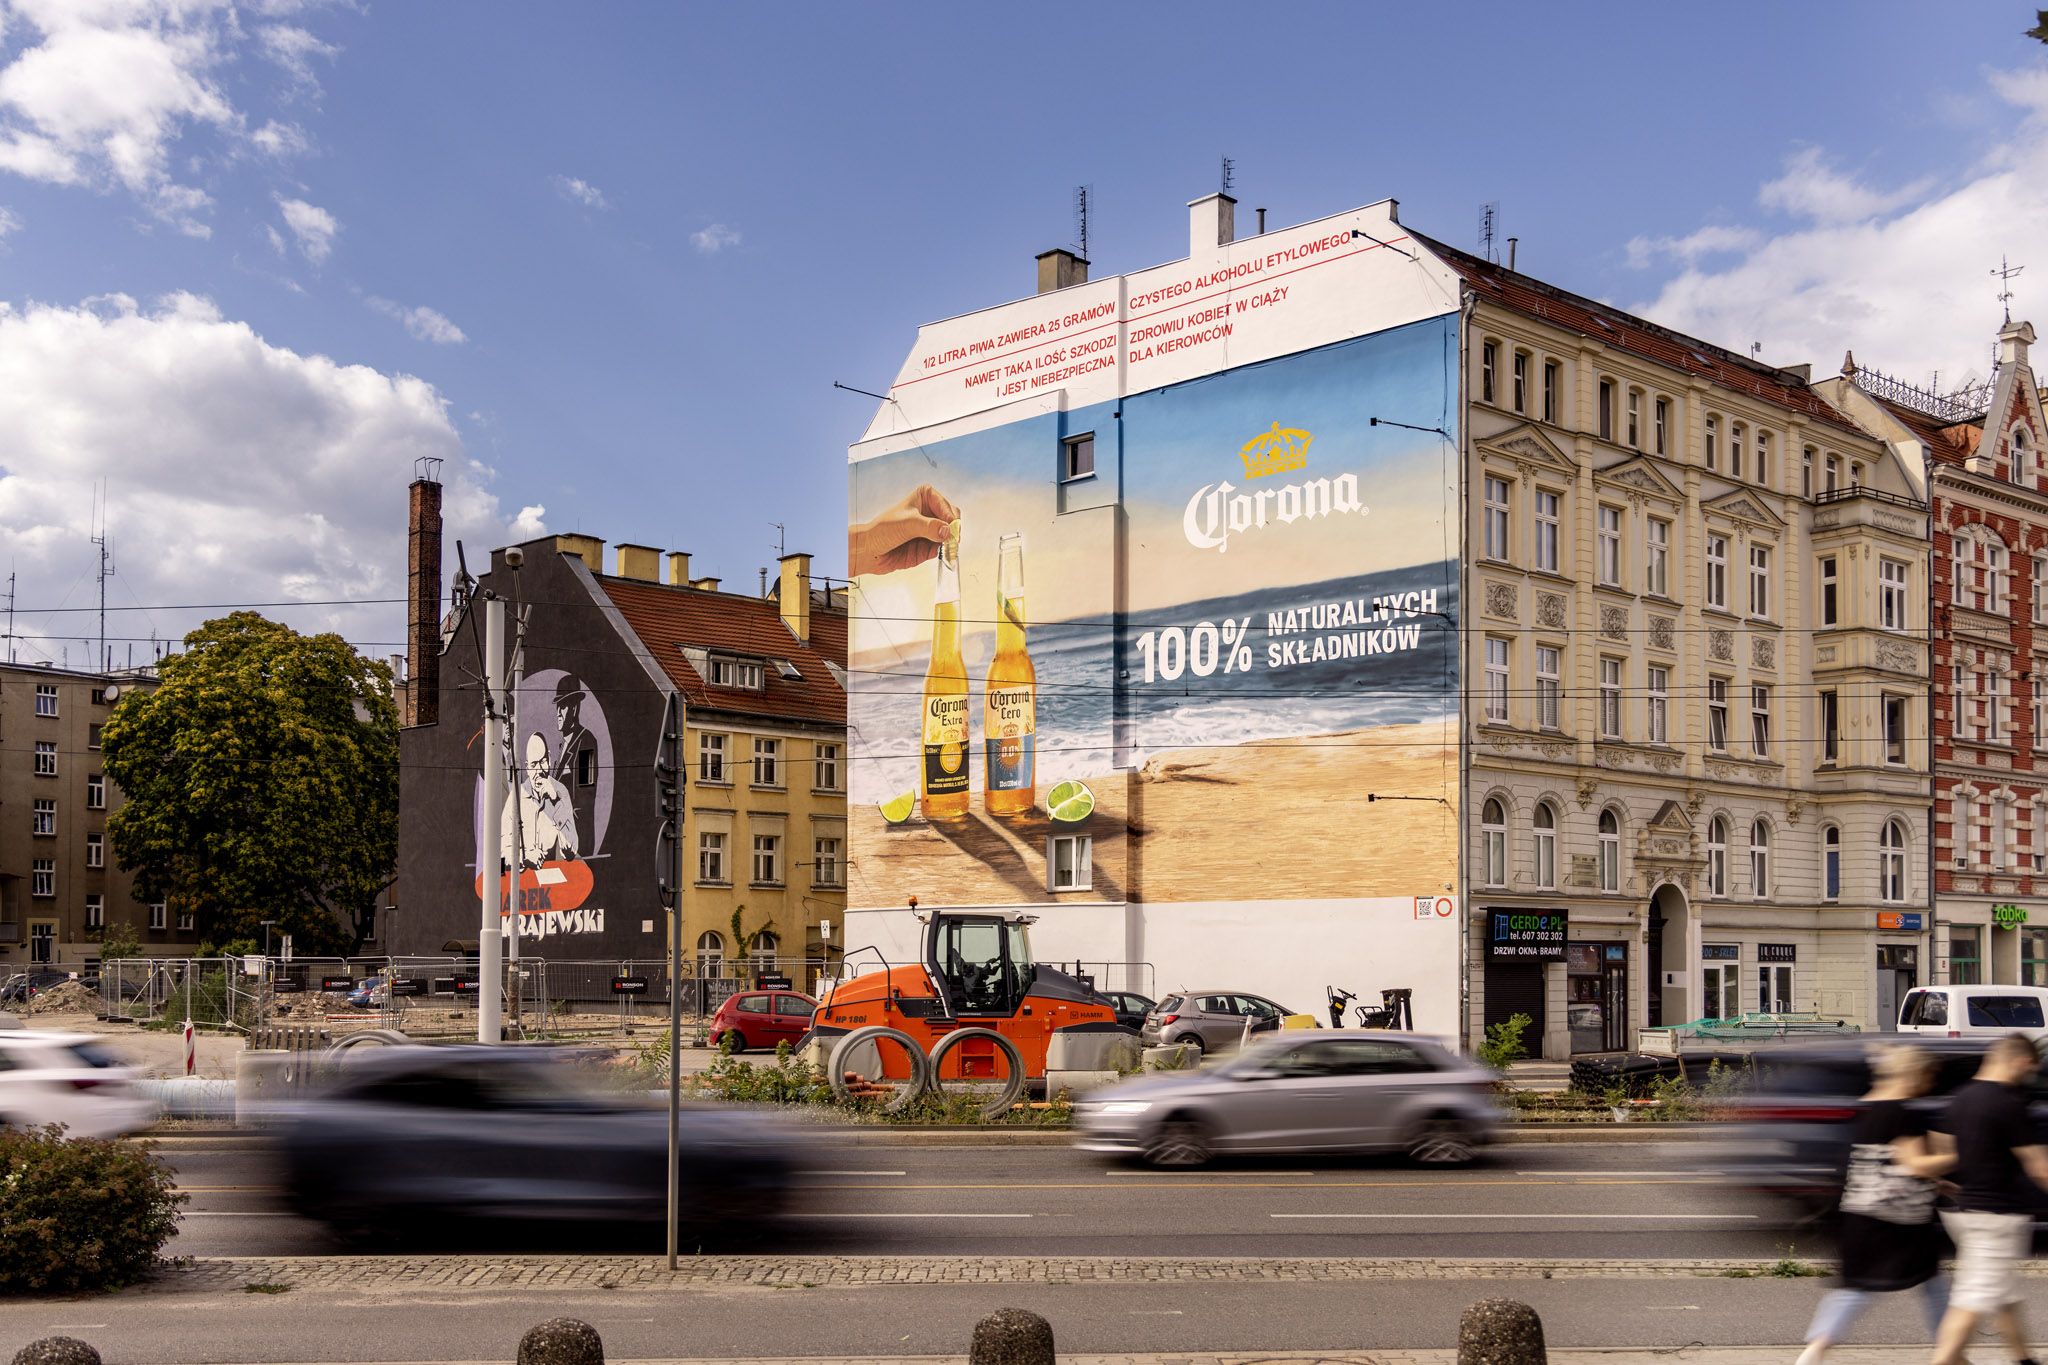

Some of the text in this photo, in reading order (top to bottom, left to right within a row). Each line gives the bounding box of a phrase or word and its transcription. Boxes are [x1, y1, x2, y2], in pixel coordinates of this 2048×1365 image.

[923, 231, 1351, 369] 1/2 LITRA PIWA ZAWIERA 25 GRAMÓW CZYSTEGO ALKOHOLU ETYLOWEGO
[965, 286, 1290, 389] NAWET TAKA ILOŚĆ SZKODZI ZDROWIU KOBIET W CIĄŻY
[996, 323, 1234, 398] I JEST NIEBEZPIECZNA DLA KIEROWCÓW
[1183, 472, 1364, 554] Corona
[1267, 588, 1438, 638] NATURALNYCH
[1135, 617, 1422, 684] 100% SKŁADNIKÓW
[930, 697, 969, 720] Corona
[989, 690, 1031, 712] Corona
[1000, 707, 1021, 720] Cero
[941, 714, 963, 727] Extra
[1493, 946, 1516, 956] DRZWI
[1510, 931, 1563, 941] tel. 607 302 302
